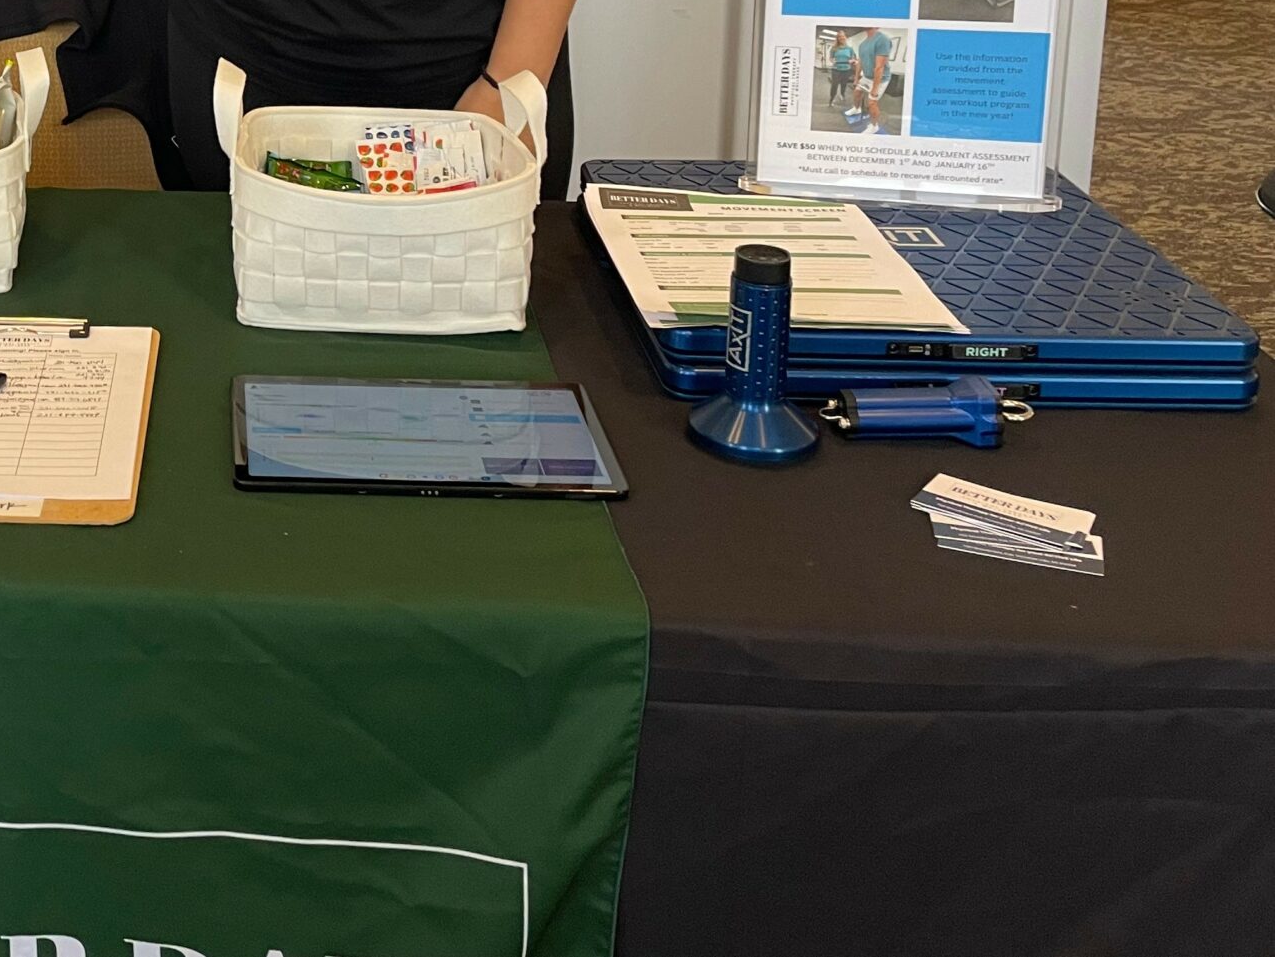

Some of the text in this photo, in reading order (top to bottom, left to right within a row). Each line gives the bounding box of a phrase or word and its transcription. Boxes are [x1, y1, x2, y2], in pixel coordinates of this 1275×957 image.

[935, 52, 1028, 62] Use the information
[982, 65, 1005, 73] from
[779, 49, 791, 113] BETTER DAYS
[932, 87, 985, 95] assessment
[1000, 90, 1026, 98] guide
[926, 98, 947, 106] your
[989, 101, 1030, 109] program
[776, 141, 797, 149] SAVE
[864, 147, 910, 155] SCHEDULE
[920, 150, 970, 158] MOVEMENT
[972, 153, 1030, 161] ASSESSMENT
[806, 153, 846, 161] BETWEEN
[848, 156, 895, 164] DECEMBER
[911, 159, 931, 167] AND
[934, 161, 975, 169] JANUARY
[851, 169, 888, 177] schedule
[932, 173, 980, 182] discounted
[610, 195, 648, 203] BETTER
[729, 309, 747, 365] AXIT
[965, 347, 1009, 357] RIGHT
[952, 487, 1013, 508] BETTER
[1015, 506, 1057, 521] DAYS
